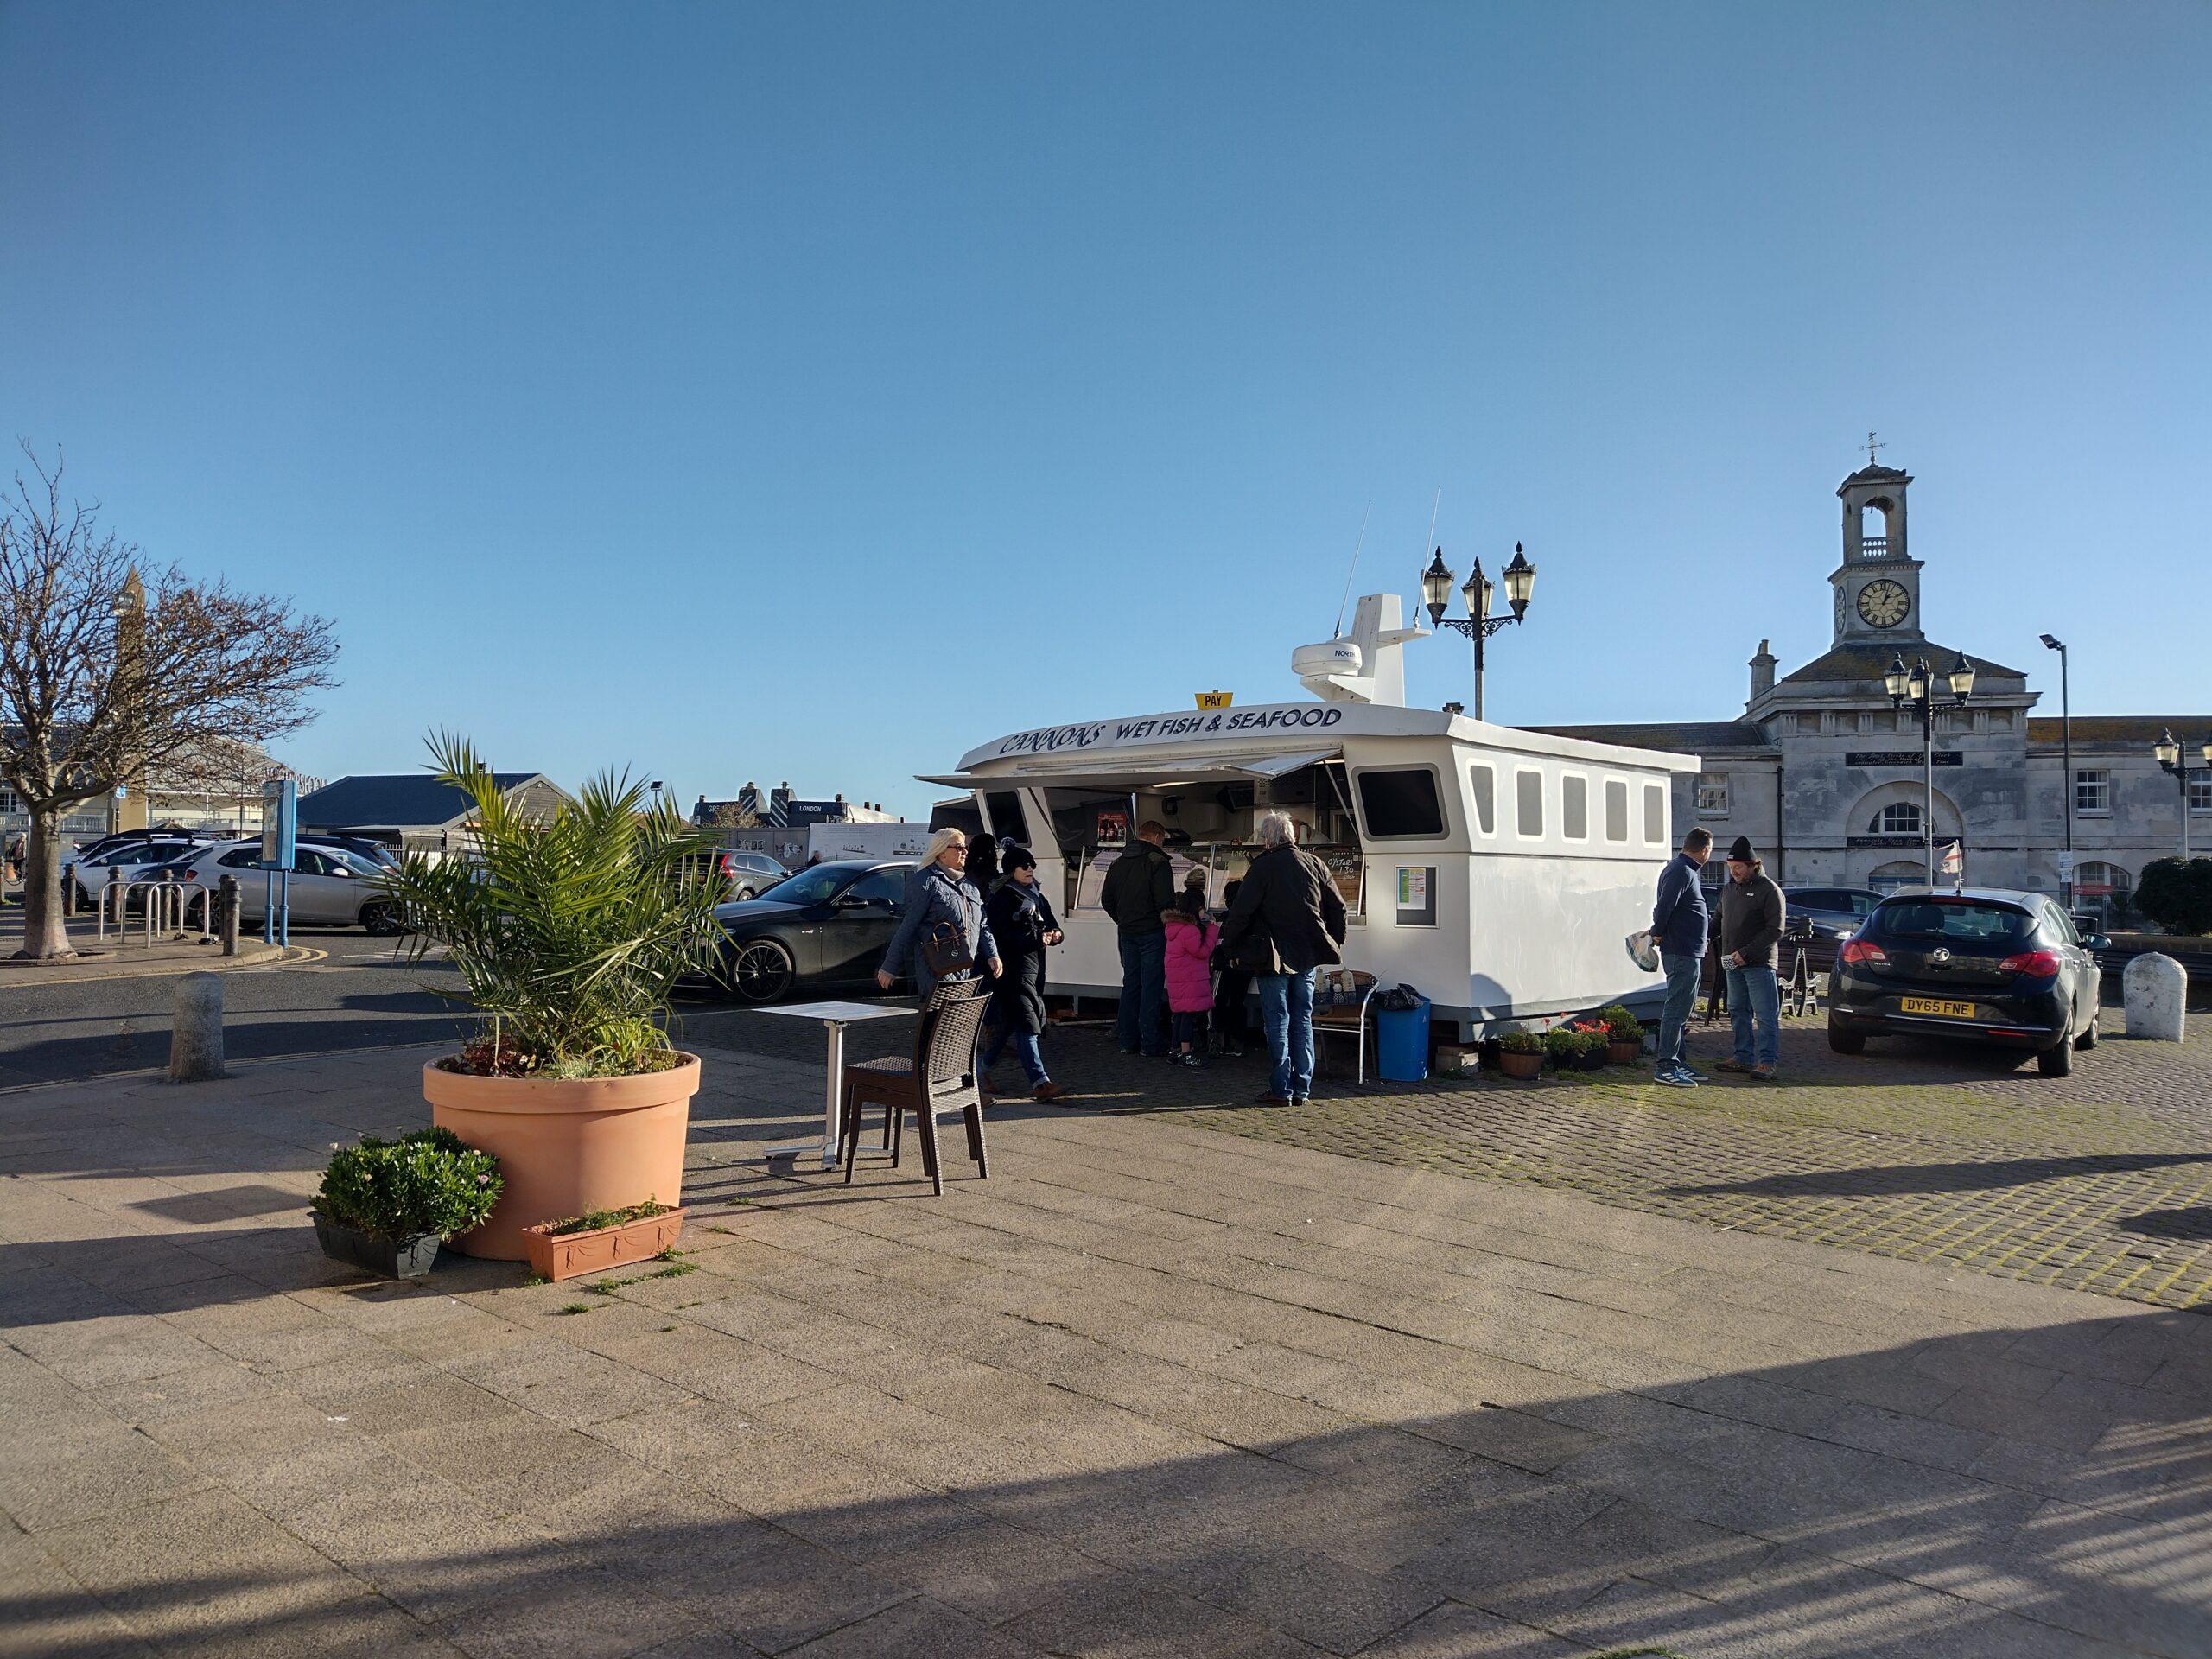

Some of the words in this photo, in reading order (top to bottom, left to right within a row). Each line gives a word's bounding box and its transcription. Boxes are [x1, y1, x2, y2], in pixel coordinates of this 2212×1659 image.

[1205, 695, 1223, 707] PAY
[999, 723, 1106, 754] CANNONS
[1116, 720, 1160, 740] WET
[1157, 716, 1205, 736] FISH
[1205, 715, 1222, 732] &
[1226, 709, 1342, 730] SEAFOOD
[1907, 999, 1941, 1013] DY65
[1943, 1002, 1970, 1015] FNE
